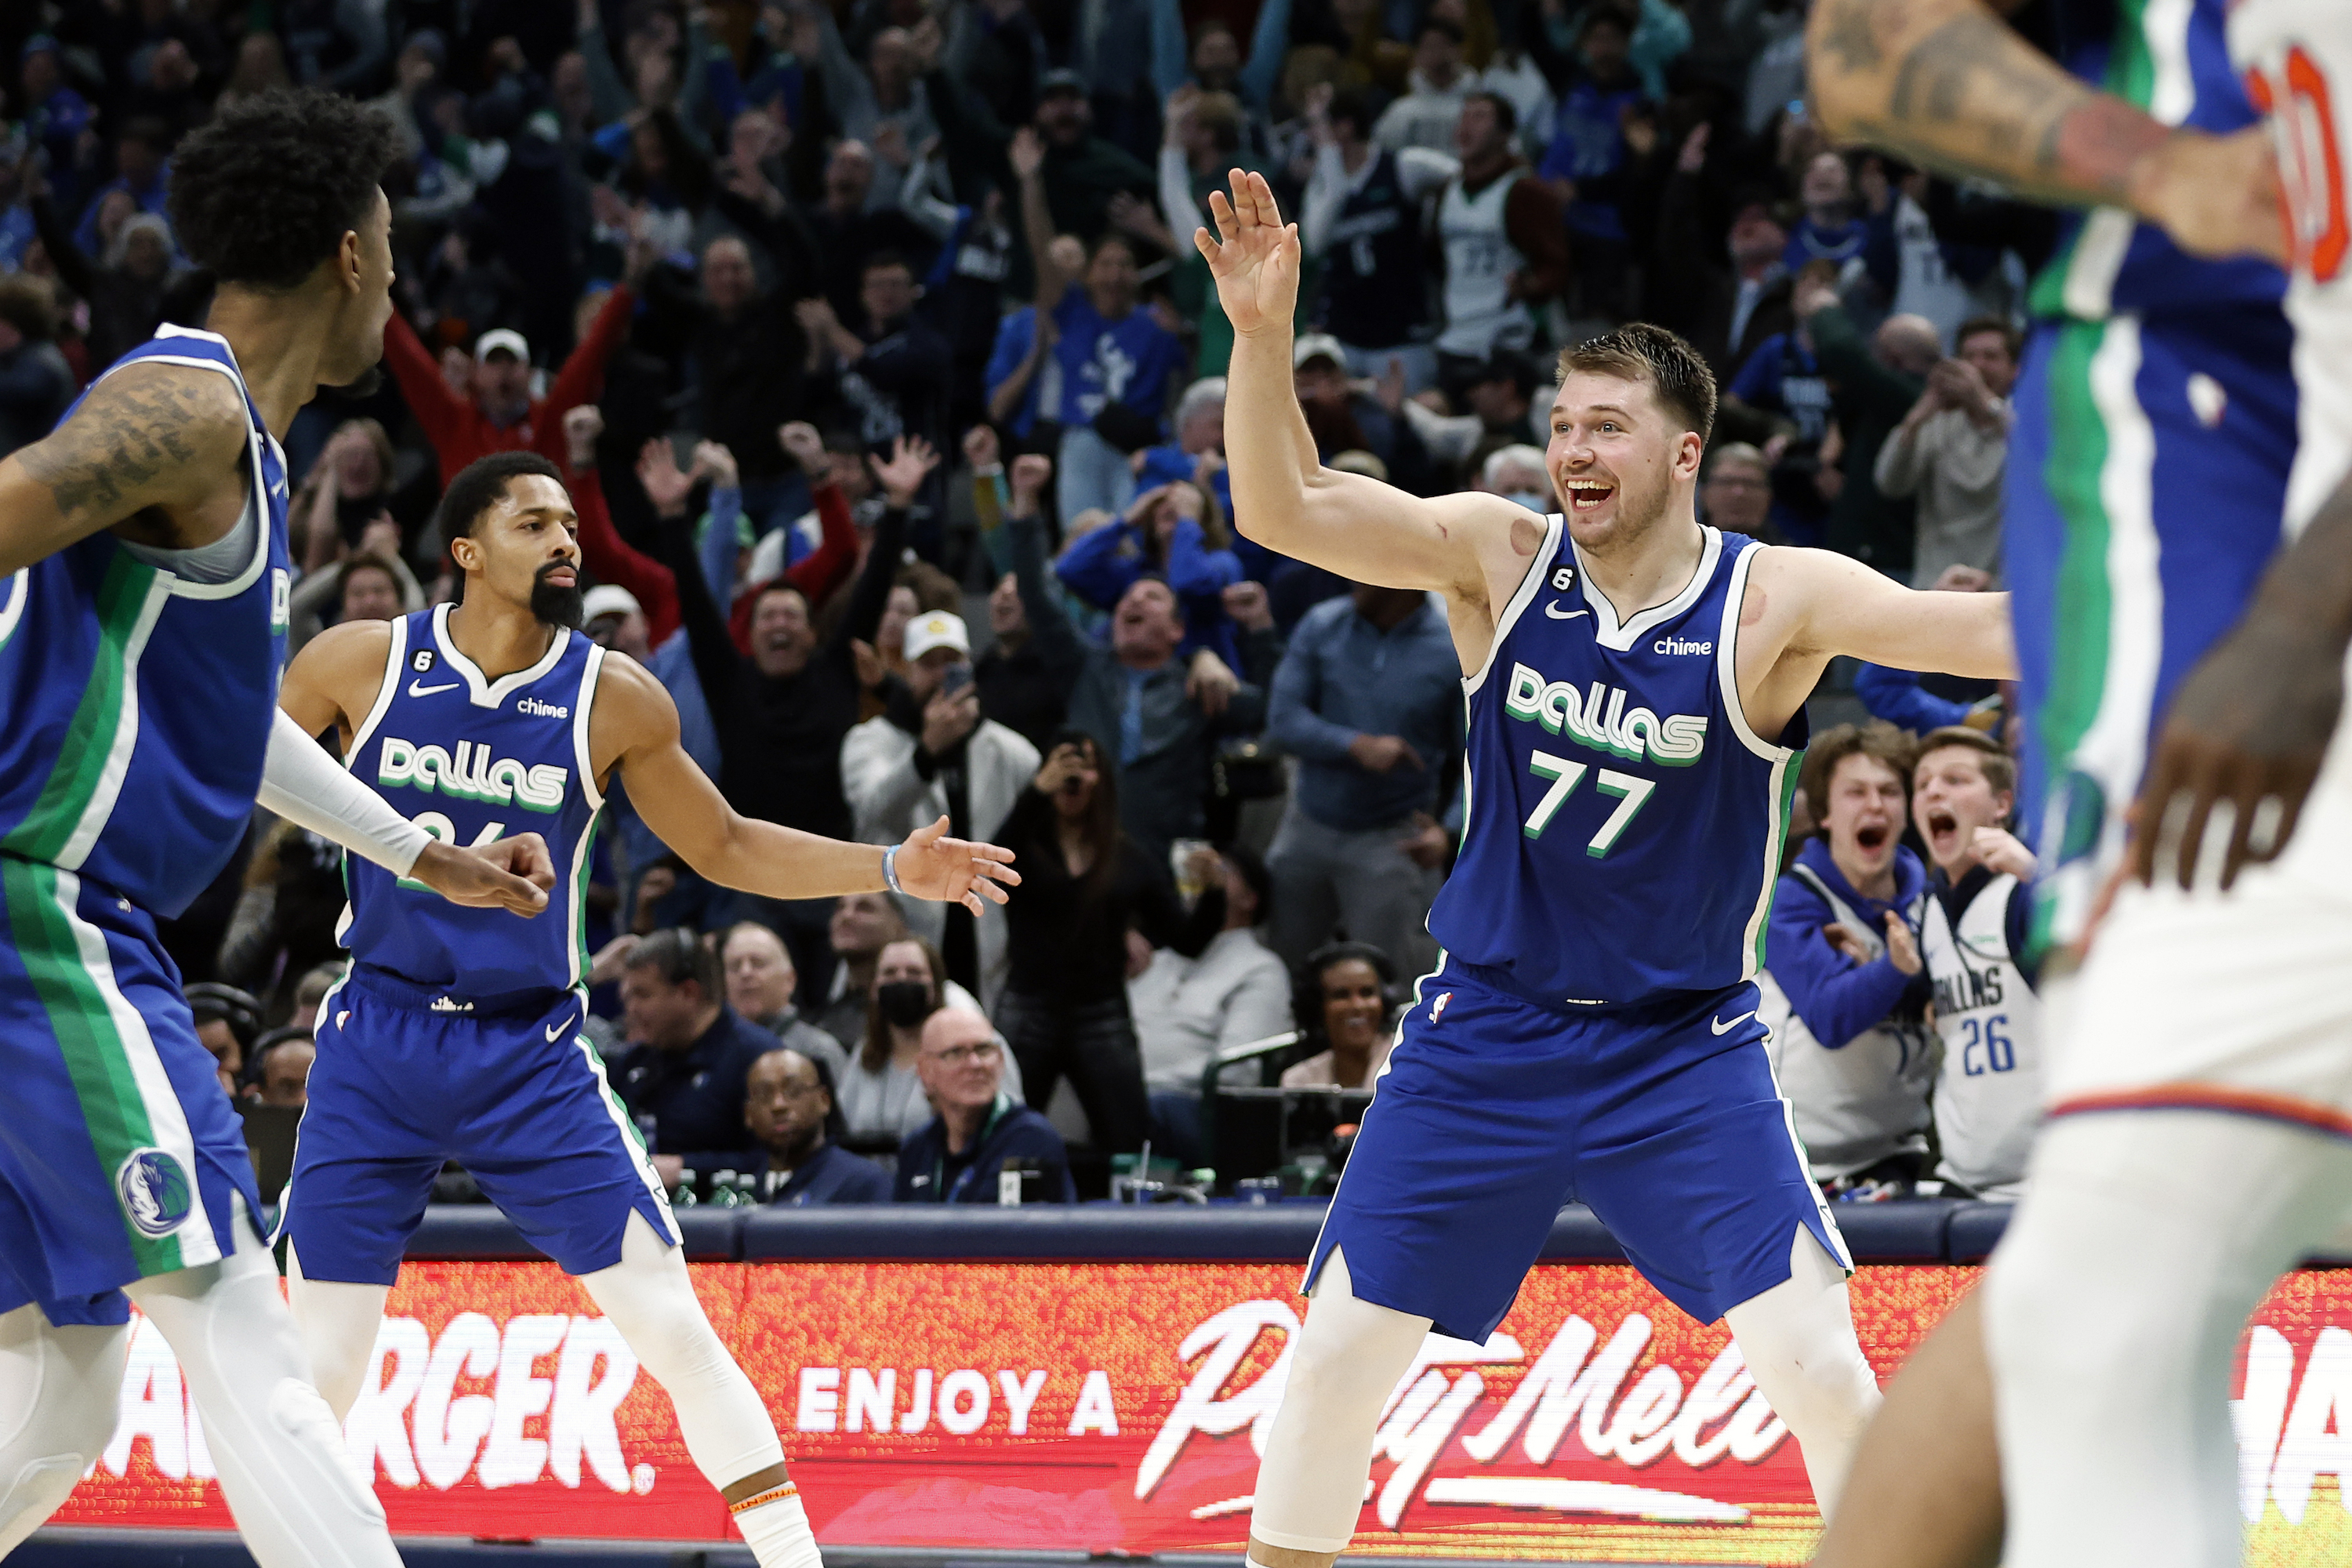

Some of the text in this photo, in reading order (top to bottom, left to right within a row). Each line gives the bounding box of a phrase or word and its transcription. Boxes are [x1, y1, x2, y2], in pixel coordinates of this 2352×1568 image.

[1552, 568, 1573, 591] 6
[1653, 636, 1713, 656] chime
[414, 651, 433, 673] 6
[517, 697, 568, 719] chime
[1523, 749, 1657, 859] 77
[1962, 1014, 2016, 1077] 26
[796, 1367, 1120, 1436] ENJOY A
